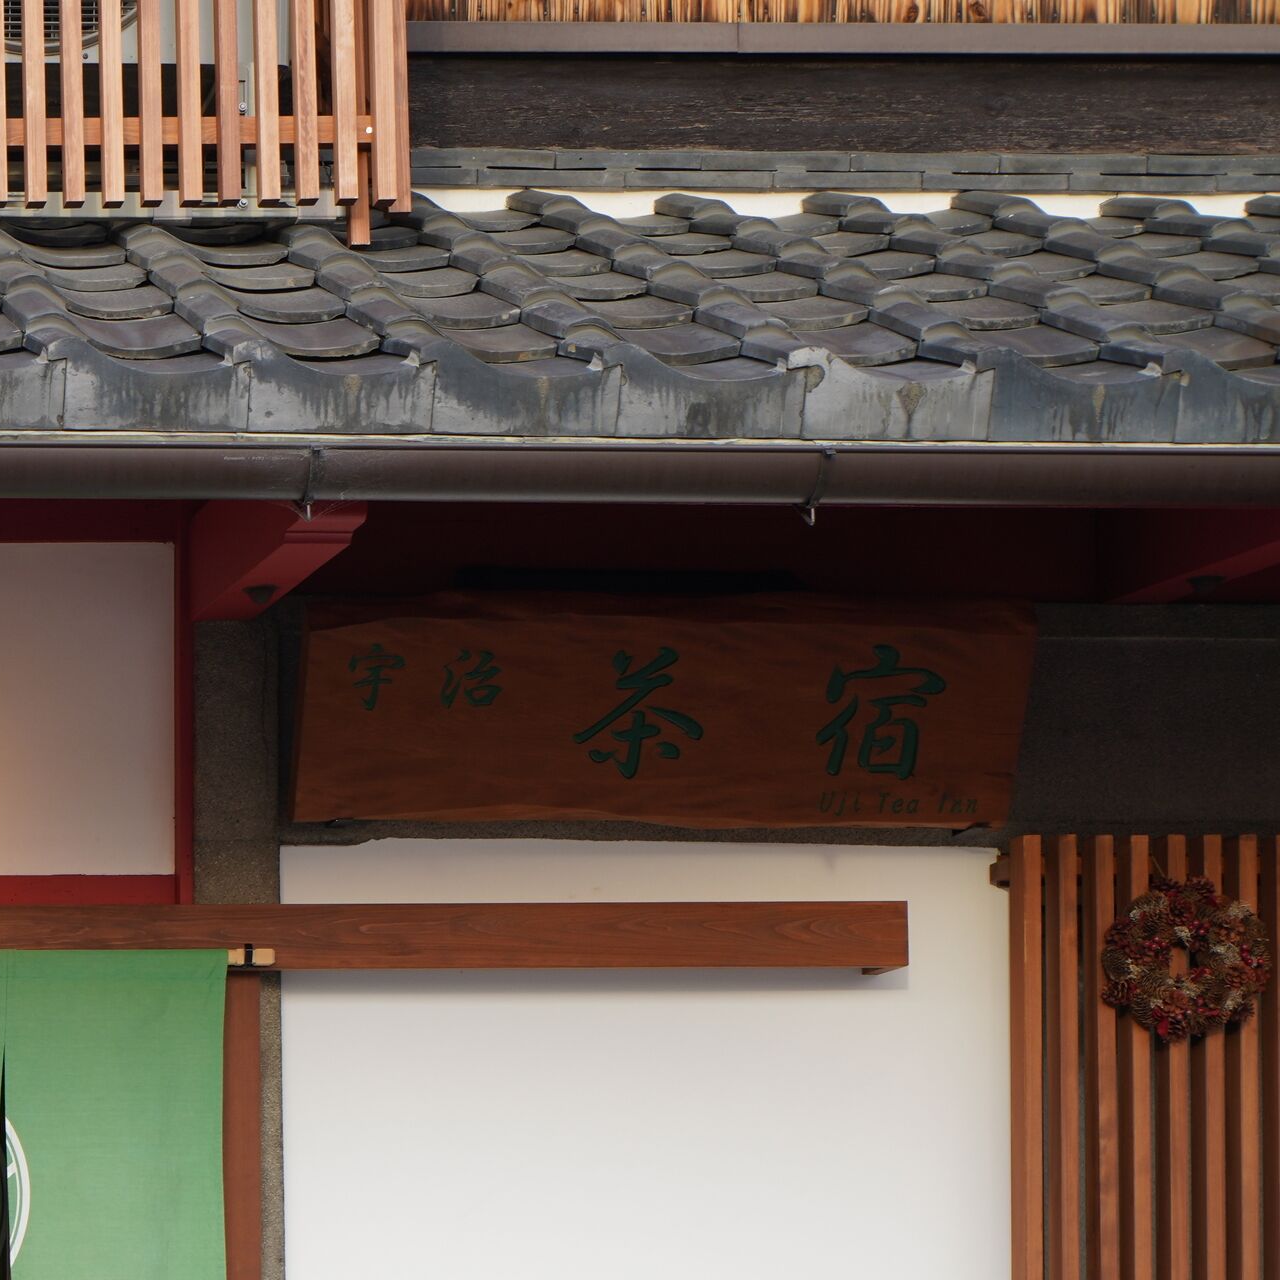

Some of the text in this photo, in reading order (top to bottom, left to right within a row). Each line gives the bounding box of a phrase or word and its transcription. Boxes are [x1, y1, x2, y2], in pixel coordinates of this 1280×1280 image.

[816, 791, 979, 817] Uji Tea Inn
